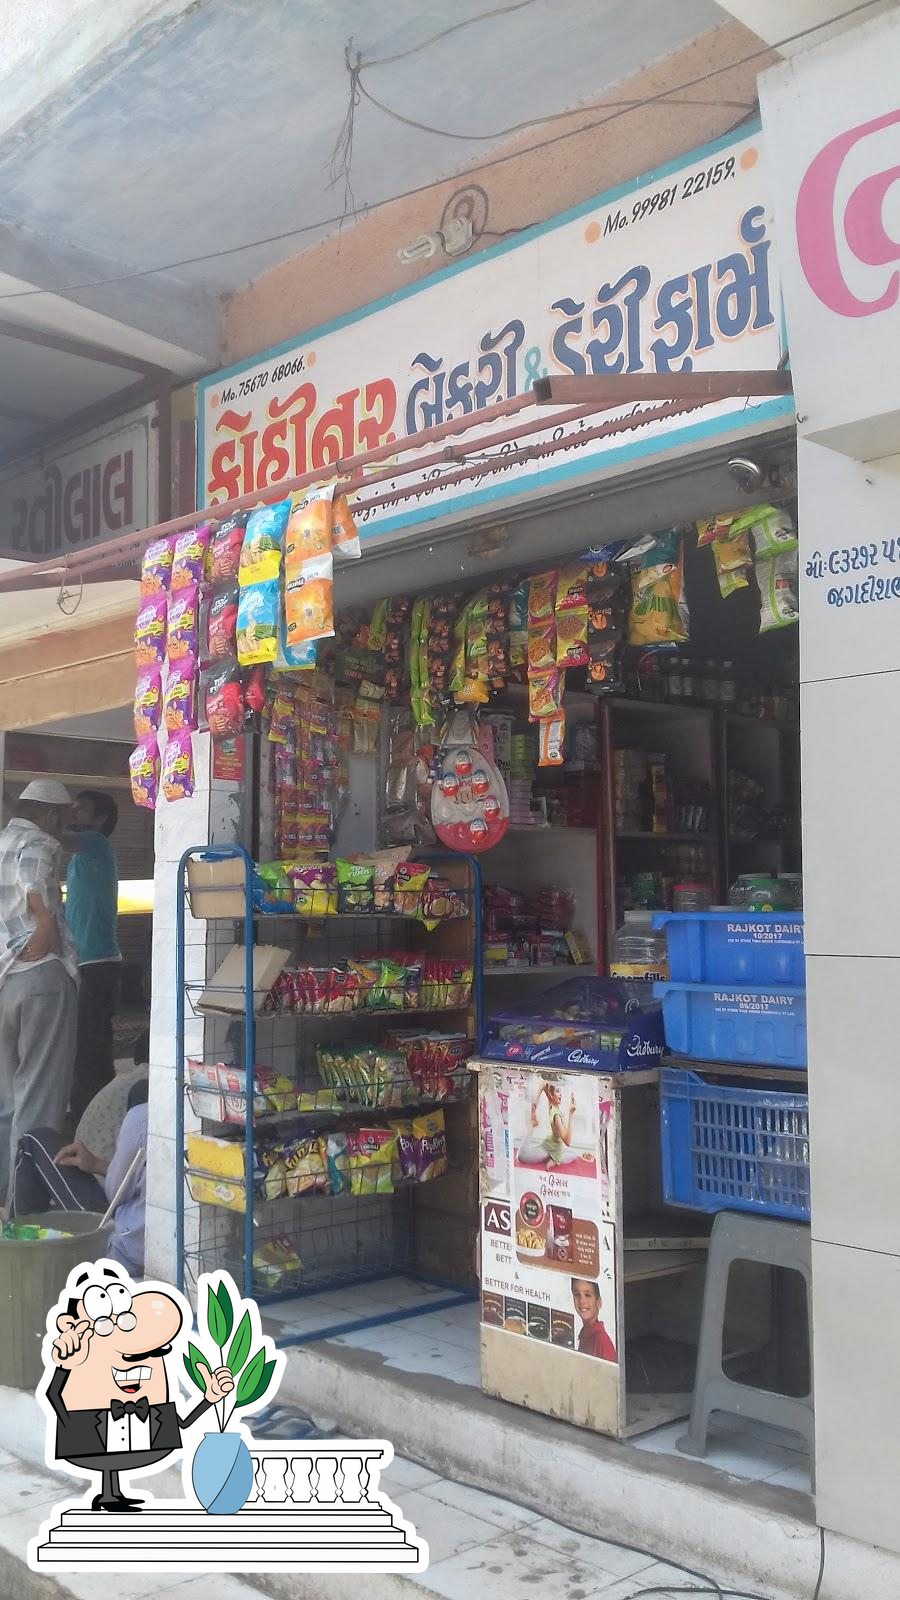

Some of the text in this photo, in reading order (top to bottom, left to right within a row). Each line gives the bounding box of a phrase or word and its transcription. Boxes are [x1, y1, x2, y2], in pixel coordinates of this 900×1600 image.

[603, 185, 679, 238] Mo.99981
[220, 371, 269, 405] Mo.75670
[881, 537, 900, 563] ૫
[727, 923, 772, 934] RAJKOT
[713, 992, 795, 1005] RAJKOT DAIRY
[626, 1034, 665, 1057] Cadbury
[567, 1049, 600, 1067] Cadbury
[484, 1277, 551, 1303] BETTER FOR HEALTH
